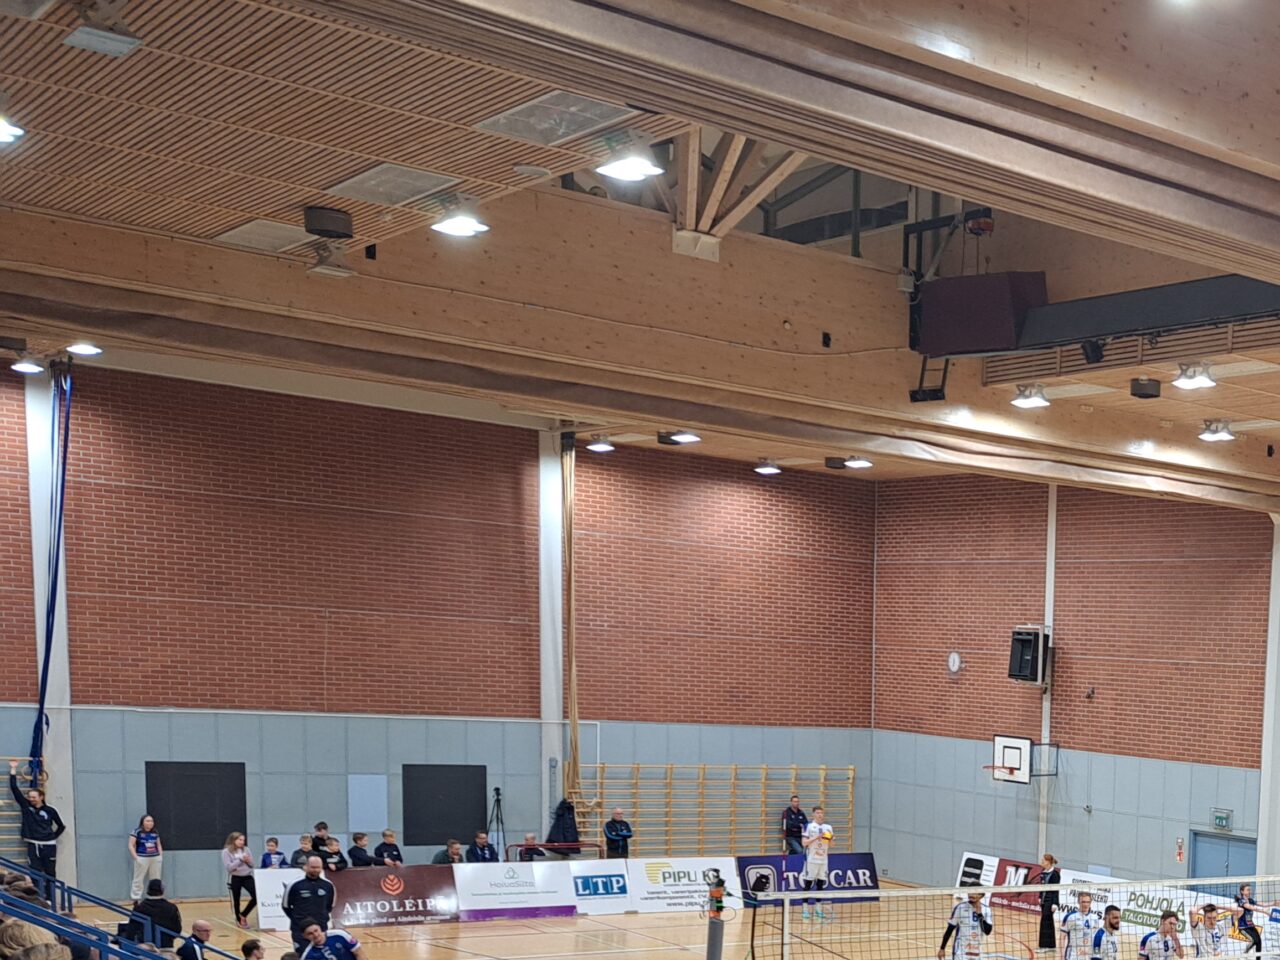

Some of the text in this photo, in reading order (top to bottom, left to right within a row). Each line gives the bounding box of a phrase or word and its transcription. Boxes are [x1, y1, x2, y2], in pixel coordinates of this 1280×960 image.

[575, 876, 624, 895] LTP
[662, 870, 698, 883] PIPU
[1127, 892, 1186, 917] POHJOLA
